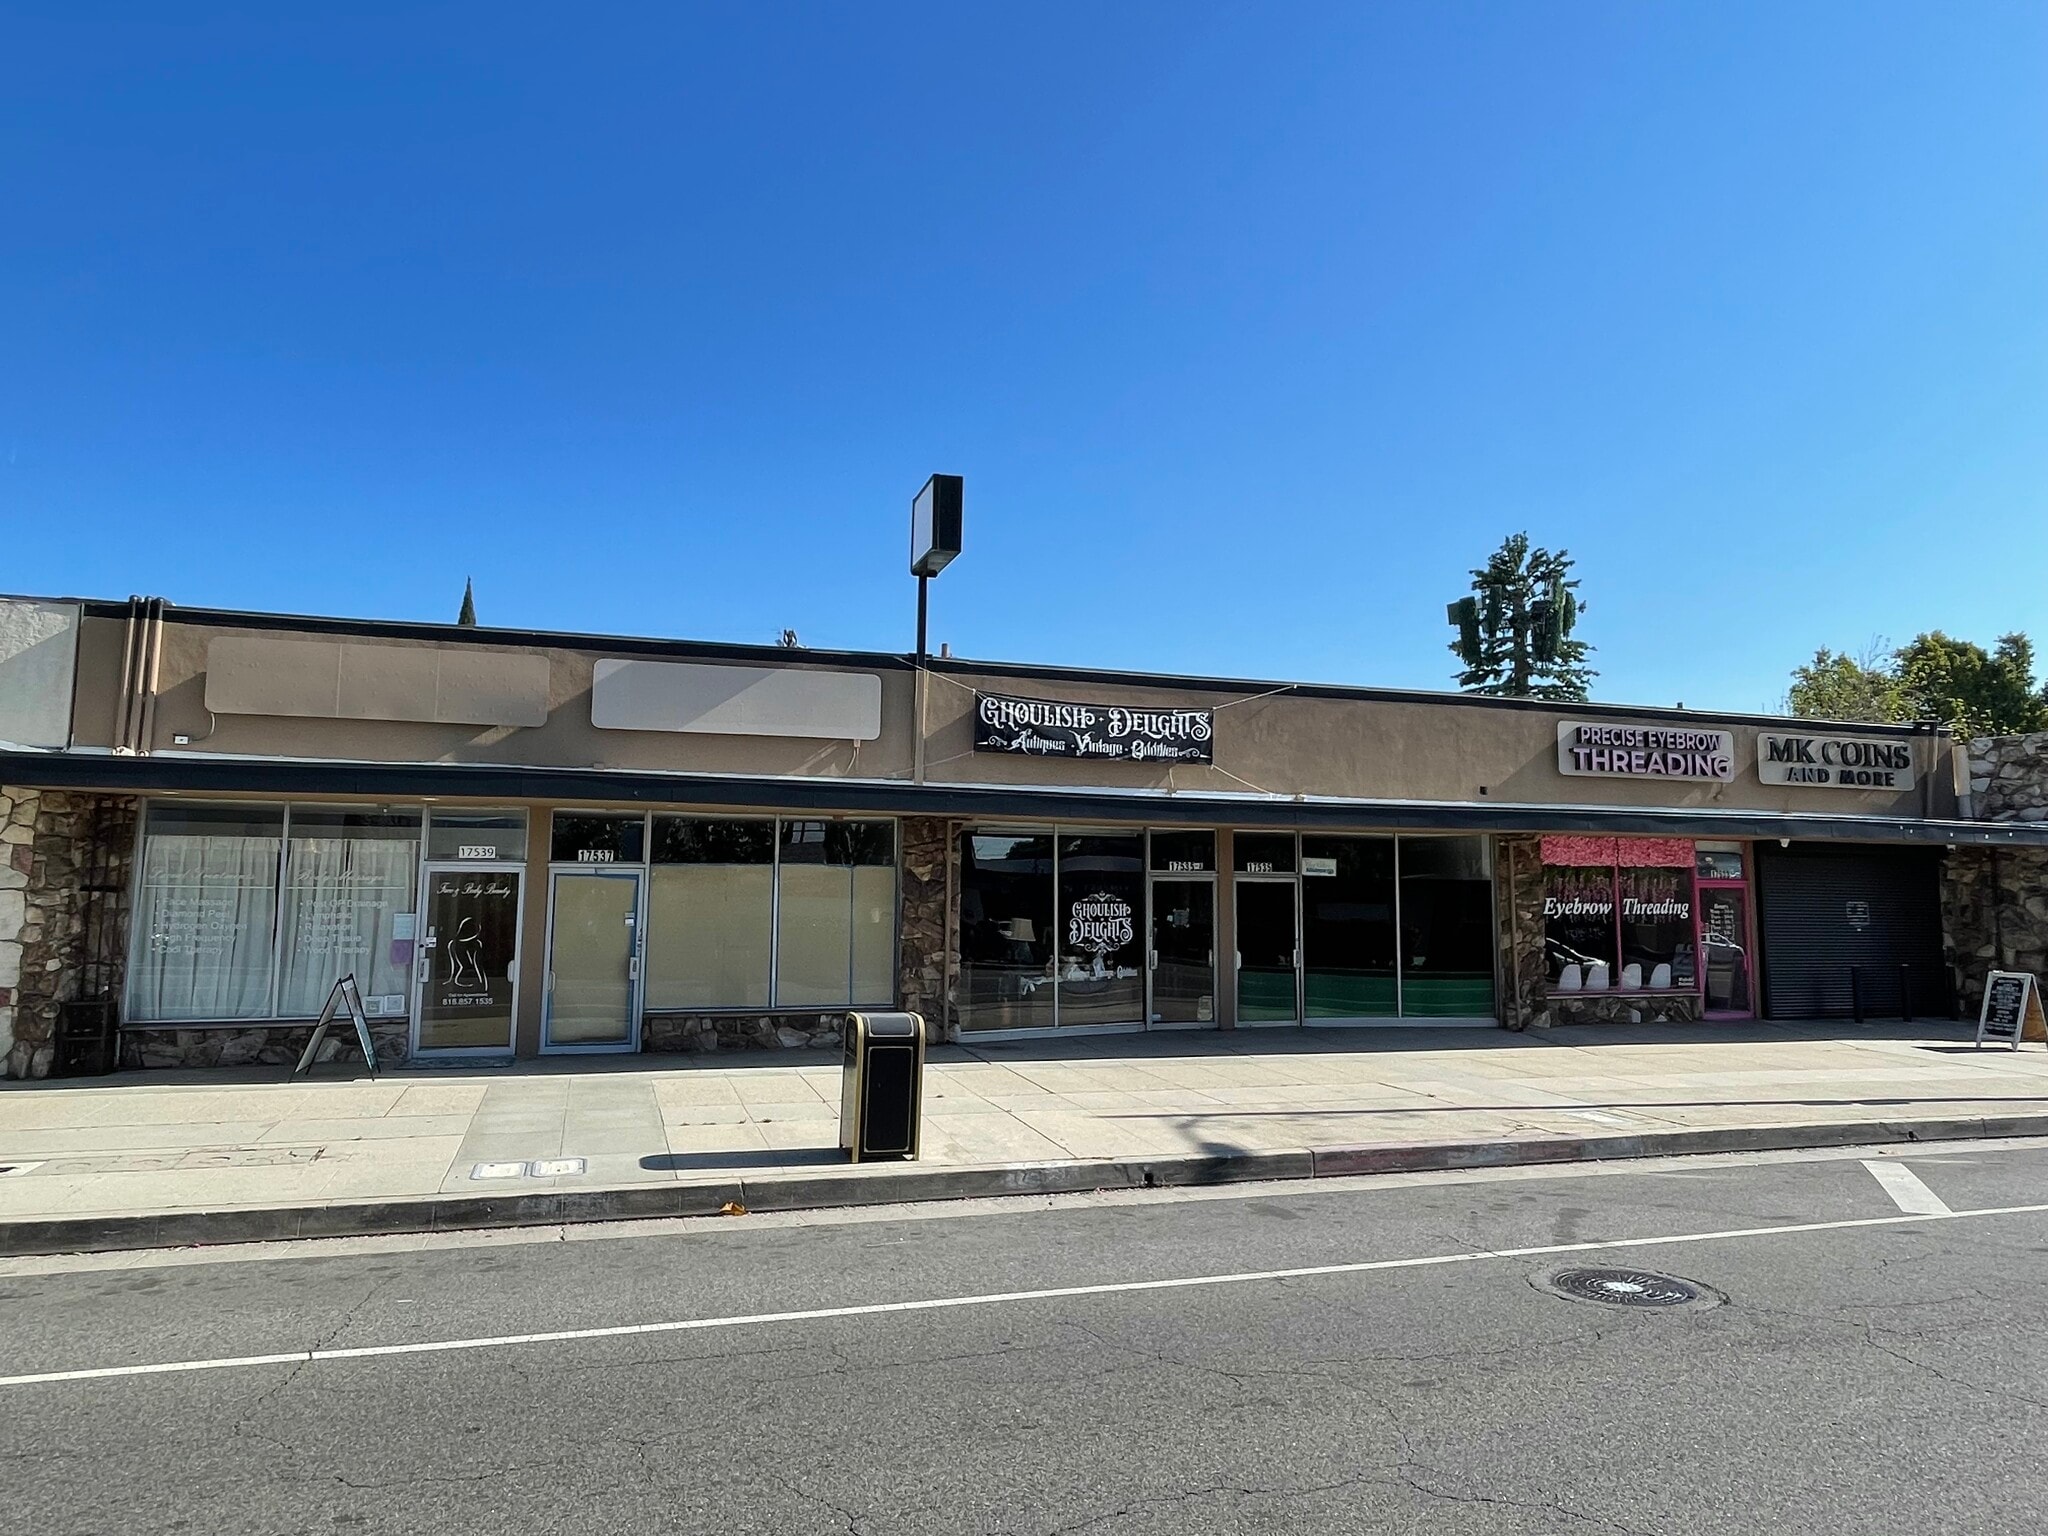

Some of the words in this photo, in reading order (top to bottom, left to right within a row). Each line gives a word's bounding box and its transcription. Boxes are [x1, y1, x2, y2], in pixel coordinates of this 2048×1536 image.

[980, 697, 1095, 731] GHOULISH
[1108, 707, 1211, 741] DELIGHTS
[1069, 730, 1123, 756] Vintage
[1580, 726, 1644, 747] PRECISE
[1649, 731, 1721, 750] EYEBROW
[1573, 747, 1731, 777] THREADING
[1768, 737, 1816, 764] MK
[1821, 741, 1910, 769] COINS
[1787, 767, 1830, 783] AND
[1840, 770, 1895, 786] MORE
[461, 847, 494, 857] 17539
[579, 850, 613, 862] 17537
[162, 909, 205, 918] Diamond
[1072, 902, 1131, 921] GHOULISH
[1543, 897, 1612, 919] Eyebrow
[1623, 897, 1689, 919] Threading
[211, 922, 247, 932] Oxygen
[1069, 917, 1133, 944] DELIGHTS
